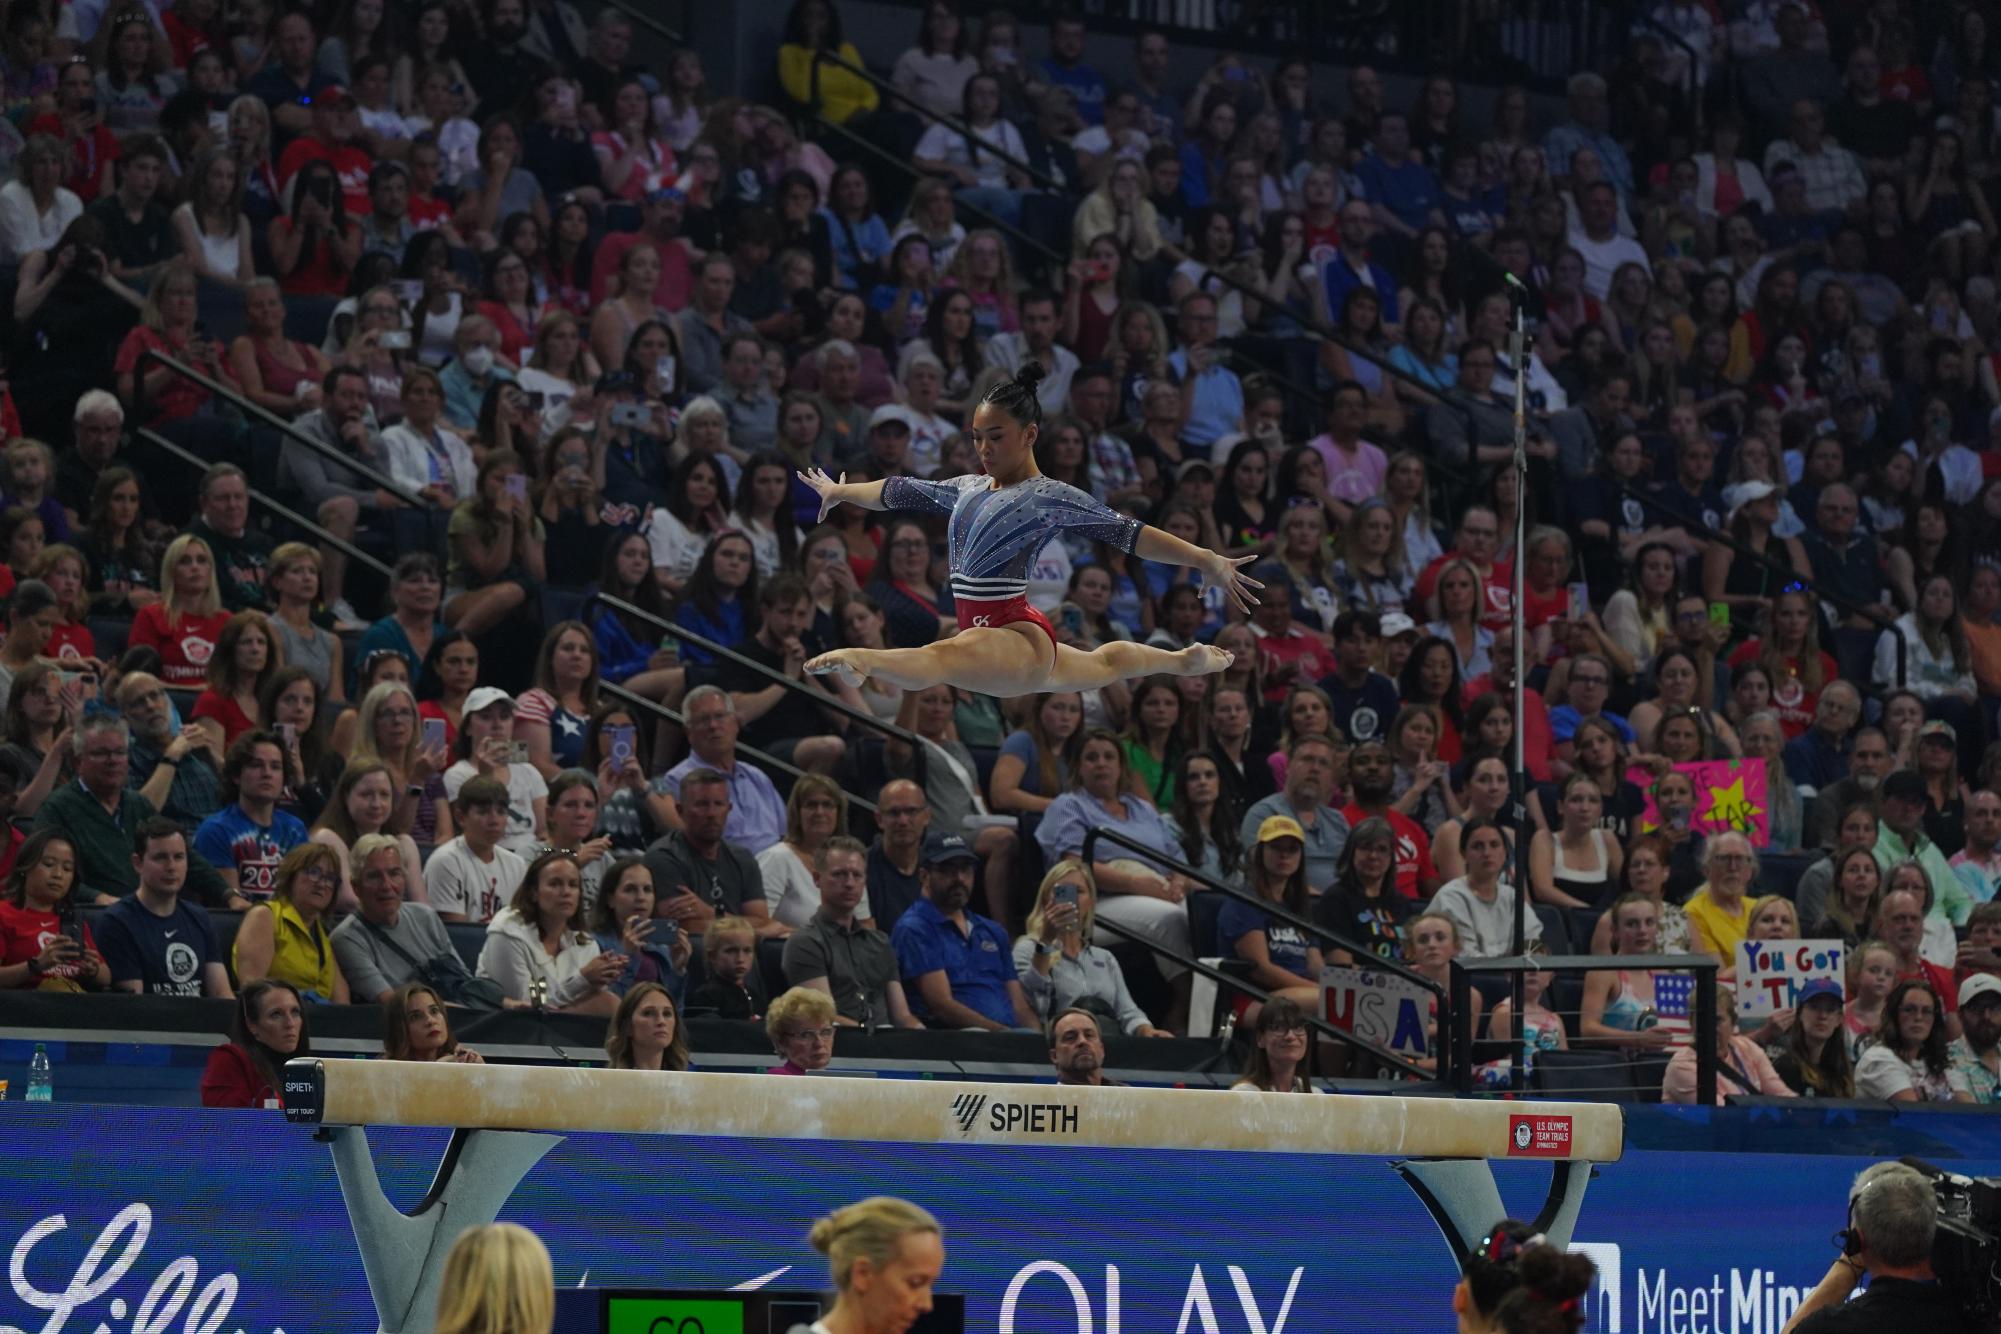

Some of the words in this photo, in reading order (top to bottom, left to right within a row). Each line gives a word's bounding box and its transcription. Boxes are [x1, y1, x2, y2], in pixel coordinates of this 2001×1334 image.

[1325, 986, 1427, 1054] USA
[285, 1082, 313, 1092] SPIETH
[990, 1102, 1079, 1133] SPIETH
[1536, 1121, 1545, 1130] U.S.
[1547, 1121, 1569, 1132] OLYMPIC
[1536, 1132, 1551, 1141] TEAM
[1551, 1132, 1569, 1142] TRIALS
